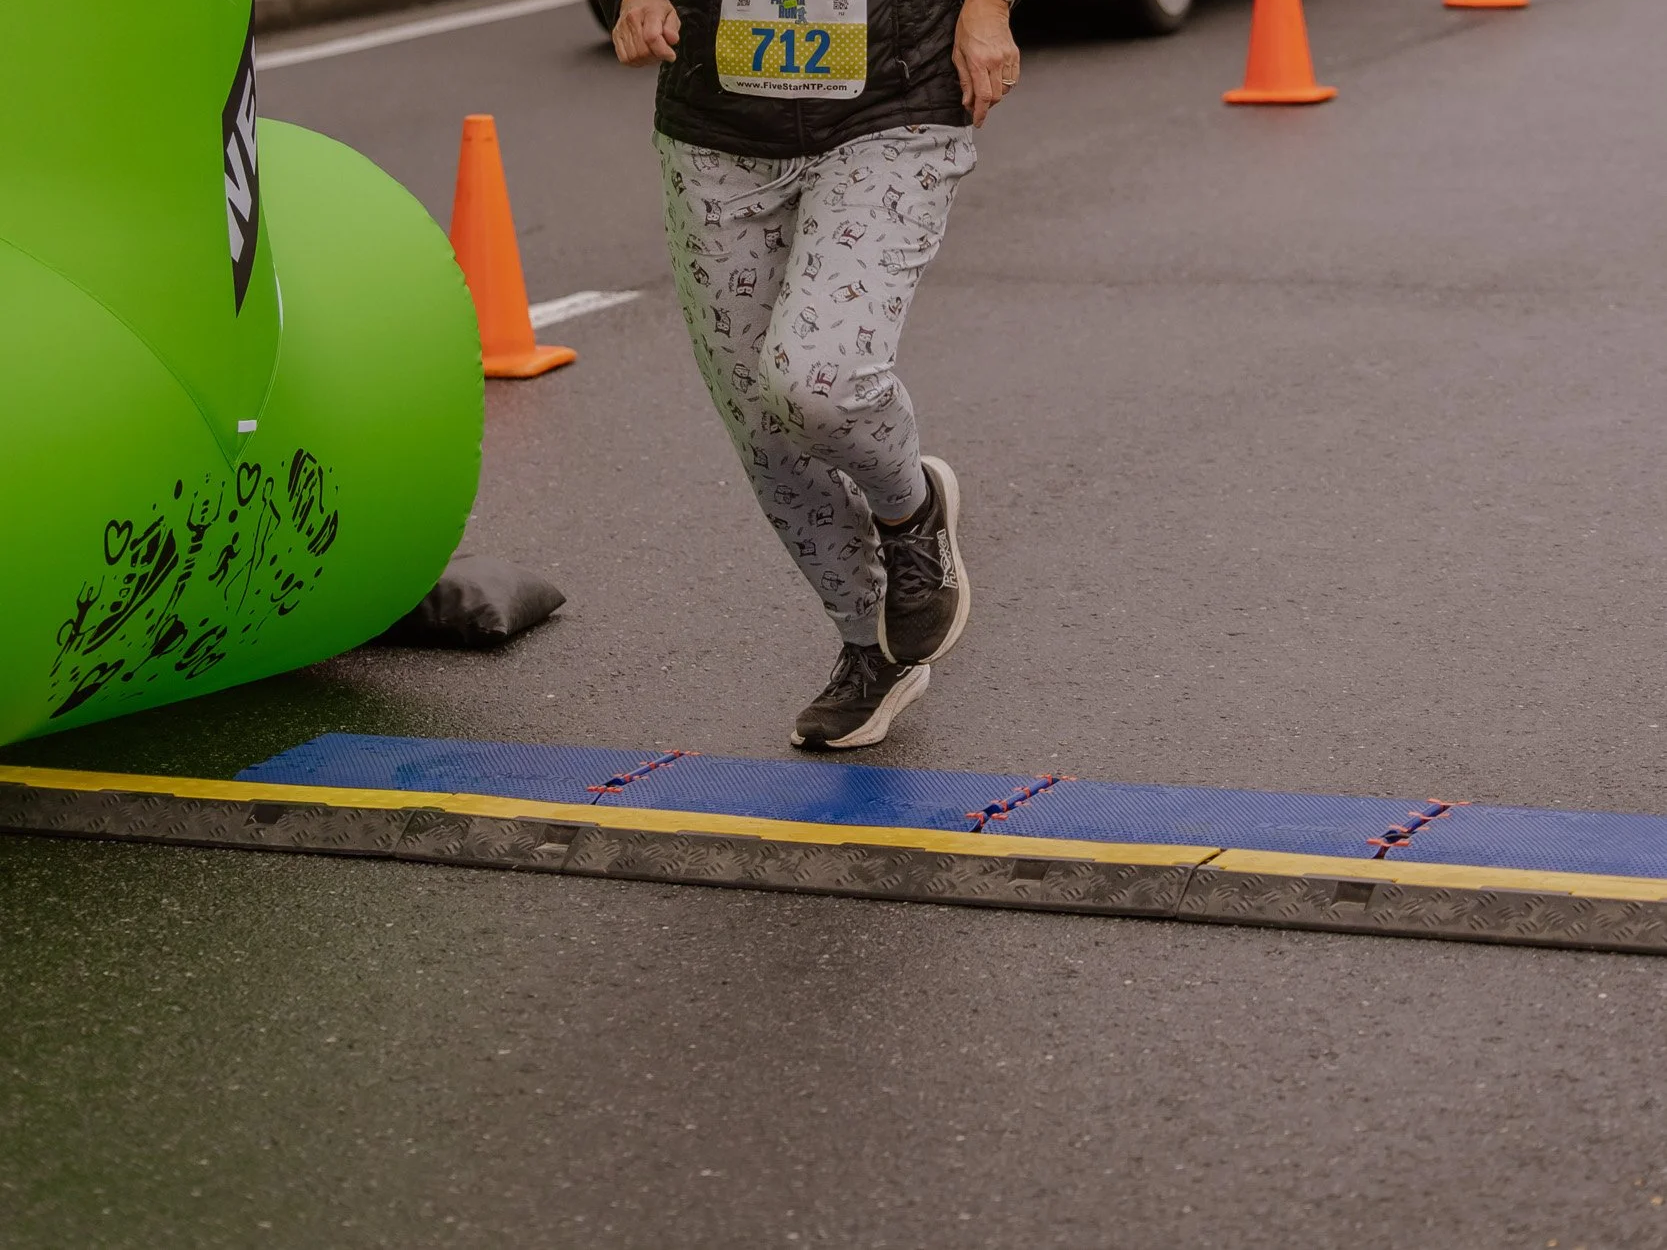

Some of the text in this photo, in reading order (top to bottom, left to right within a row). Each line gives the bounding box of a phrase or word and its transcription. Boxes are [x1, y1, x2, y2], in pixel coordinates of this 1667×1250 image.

[778, 5, 798, 19] RUN
[751, 28, 831, 74] 712
[736, 80, 848, 92] www.FiveStarNTP.com
